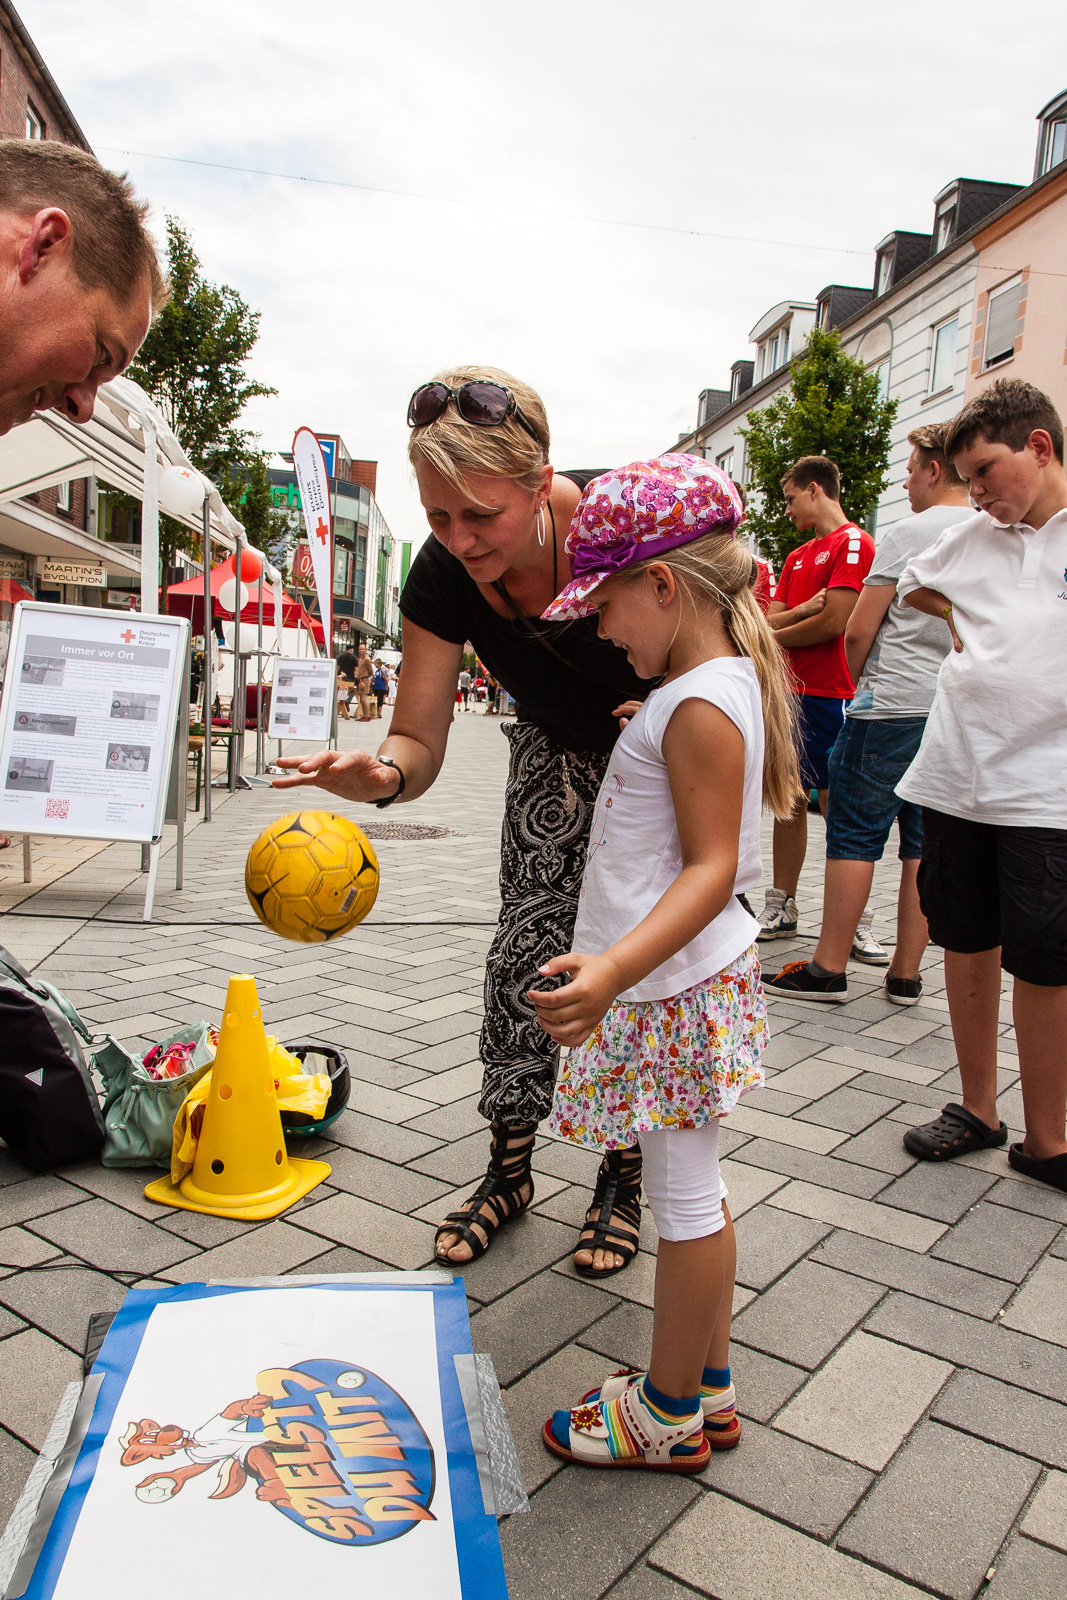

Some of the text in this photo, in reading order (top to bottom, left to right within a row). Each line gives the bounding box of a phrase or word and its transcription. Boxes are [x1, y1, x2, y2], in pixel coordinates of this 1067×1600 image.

[44, 564, 103, 576] MARTIN'S
[43, 573, 103, 584] EVOLUTION
[140, 629, 170, 638] Deutsches
[60, 644, 135, 660] Immer vor Ort
[315, 1390, 408, 1461] MIT
[262, 1402, 376, 1540] SPIELST
[348, 1469, 438, 1522] DU
